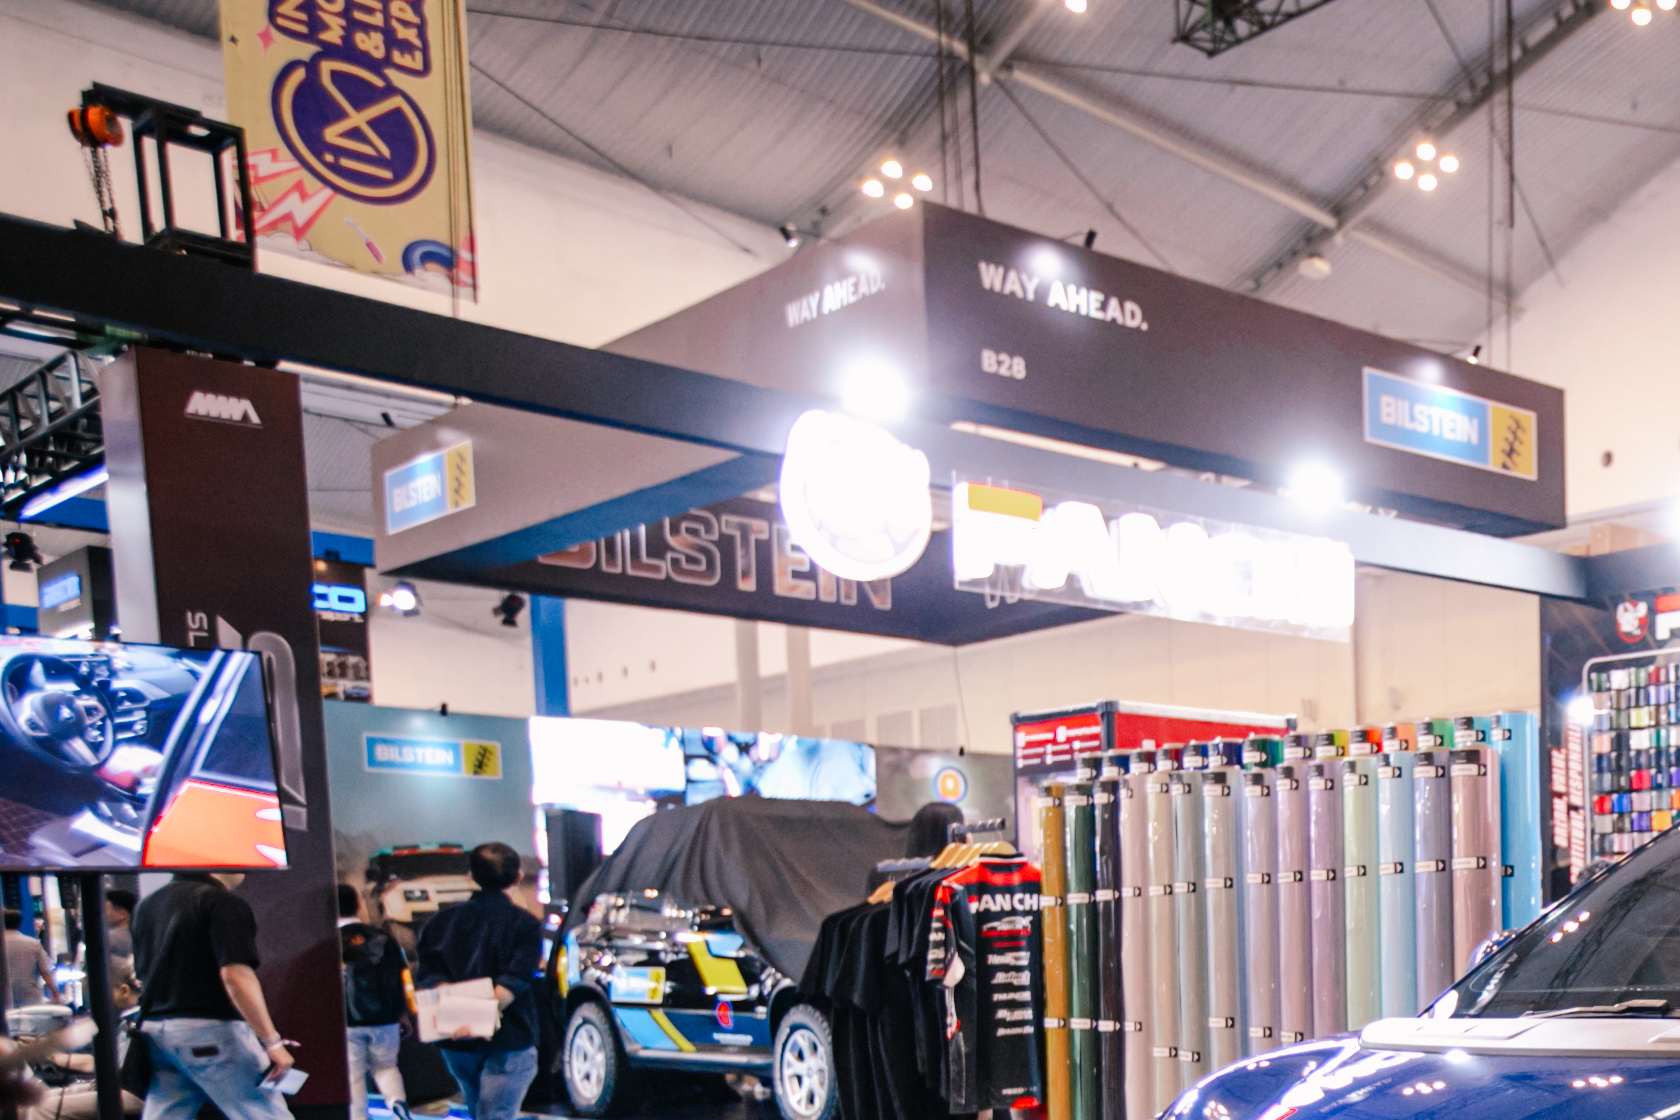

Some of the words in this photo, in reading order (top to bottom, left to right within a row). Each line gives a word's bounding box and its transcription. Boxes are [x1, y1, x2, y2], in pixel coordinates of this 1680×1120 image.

[785, 291, 820, 328] WAY
[977, 260, 1040, 301] WAY
[1047, 279, 1149, 331] AHEAD.
[981, 348, 1027, 381] B28
[1380, 394, 1479, 446] BILSTEIN
[392, 473, 442, 513] BILSTEIN
[374, 743, 455, 766] BILSTEIN
